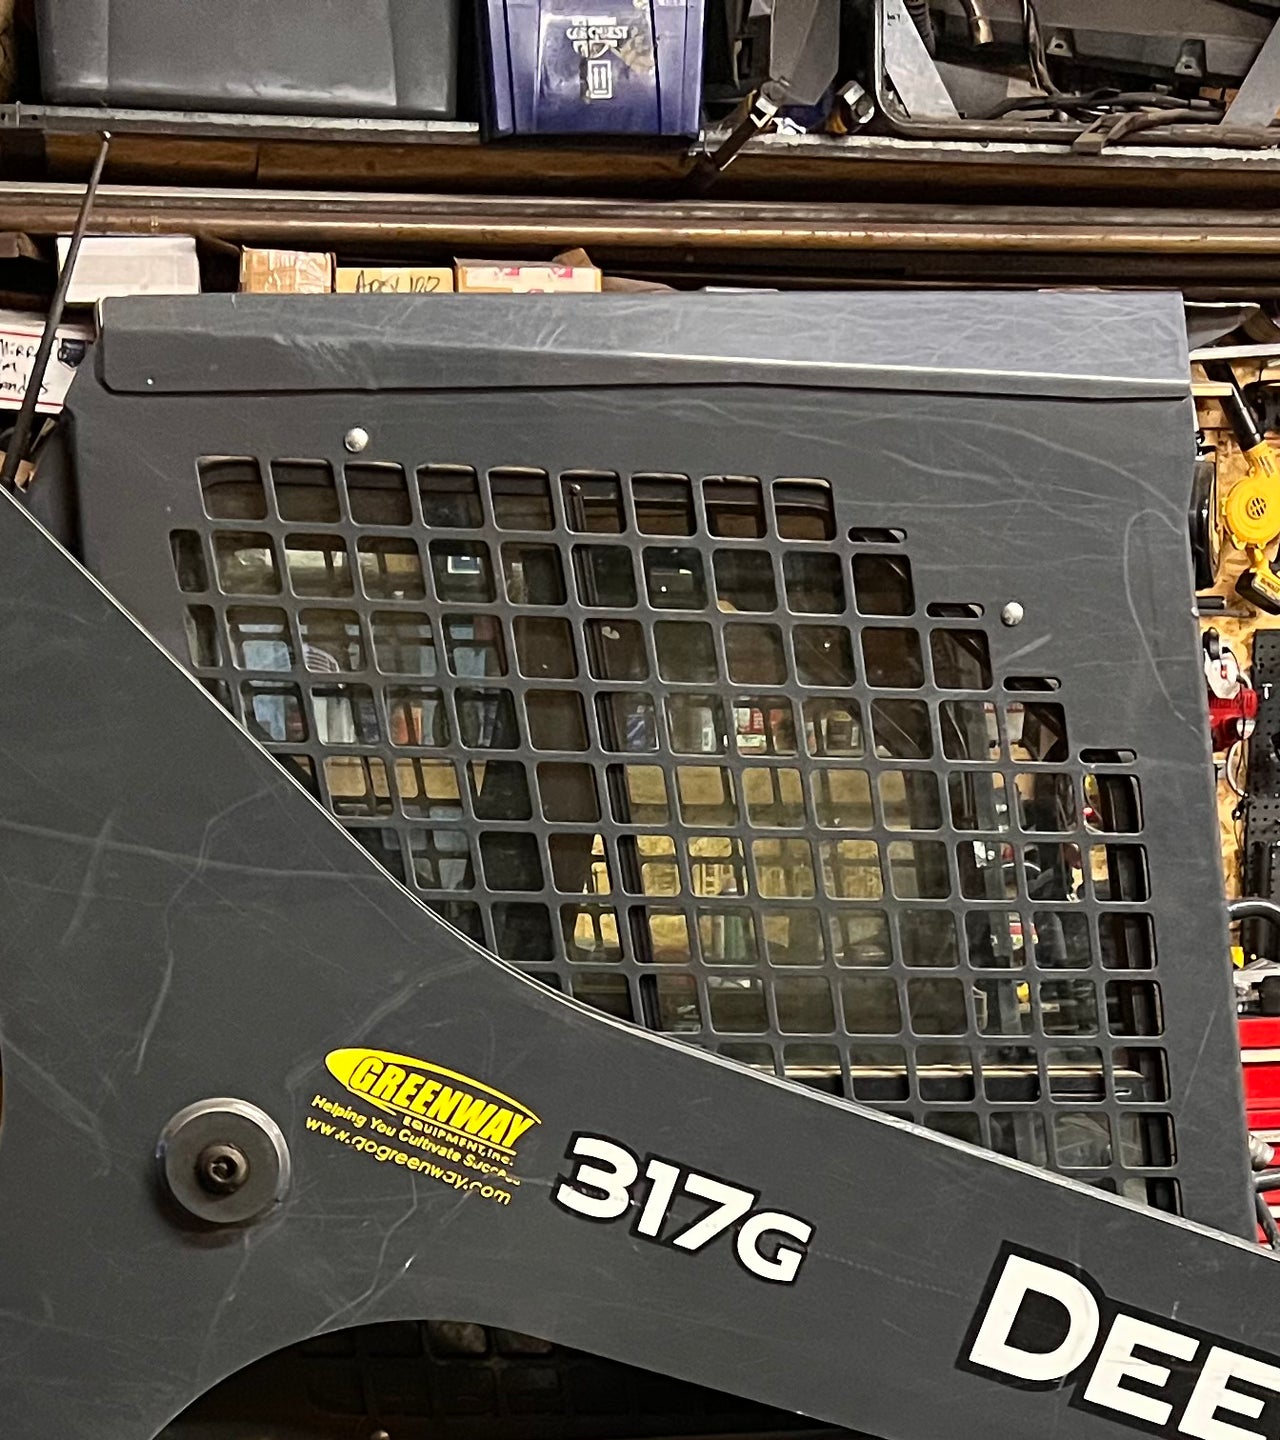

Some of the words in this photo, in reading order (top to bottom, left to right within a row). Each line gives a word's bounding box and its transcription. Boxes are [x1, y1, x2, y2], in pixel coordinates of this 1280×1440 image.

[311, 1095, 366, 1128] Helping
[370, 1113, 396, 1136] You
[399, 1125, 461, 1165] Cultivate
[349, 1057, 536, 1148] GREENWAY
[304, 1115, 511, 1206] www.gogreenway.com
[556, 1137, 813, 1282] 317G
